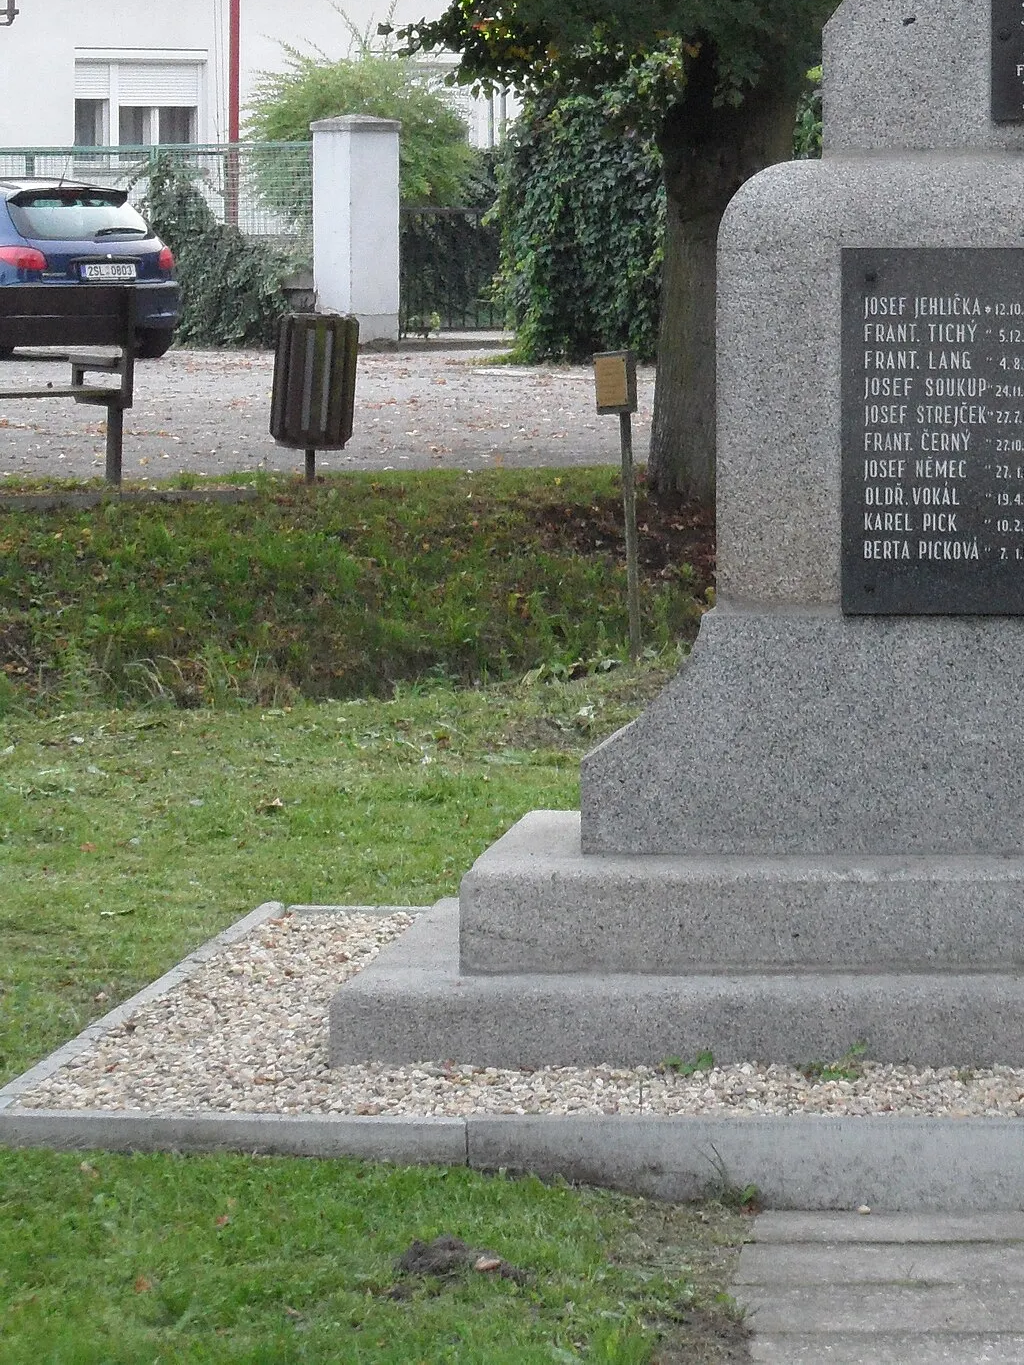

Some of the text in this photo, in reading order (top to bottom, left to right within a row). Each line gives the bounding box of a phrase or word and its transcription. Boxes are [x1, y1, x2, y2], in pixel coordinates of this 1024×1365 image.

[88, 266, 104, 276] 2SL
[864, 297, 906, 319] JOSEF
[914, 293, 981, 319] JEHLIČKA
[864, 324, 920, 342] FRANT.
[928, 320, 977, 342] TICHÝ
[864, 351, 920, 369] FRANT.
[929, 351, 972, 369] LANG
[864, 378, 913, 399] JOSEF
[925, 378, 986, 397] SOUKUP
[864, 405, 908, 426] JOSEF
[916, 402, 987, 426] STREJČEK
[864, 433, 913, 451] FRANT.
[921, 429, 970, 451] ČERNÝ
[864, 460, 906, 481] JOSEF
[916, 456, 967, 478] NĚMEC
[865, 483, 908, 505] OLDŘ.
[912, 481, 960, 505] VOKÁL
[864, 513, 913, 531] KAREL
[923, 513, 957, 531] PICK
[864, 541, 910, 559] BERTA
[919, 537, 979, 560] PICKOVÁ
